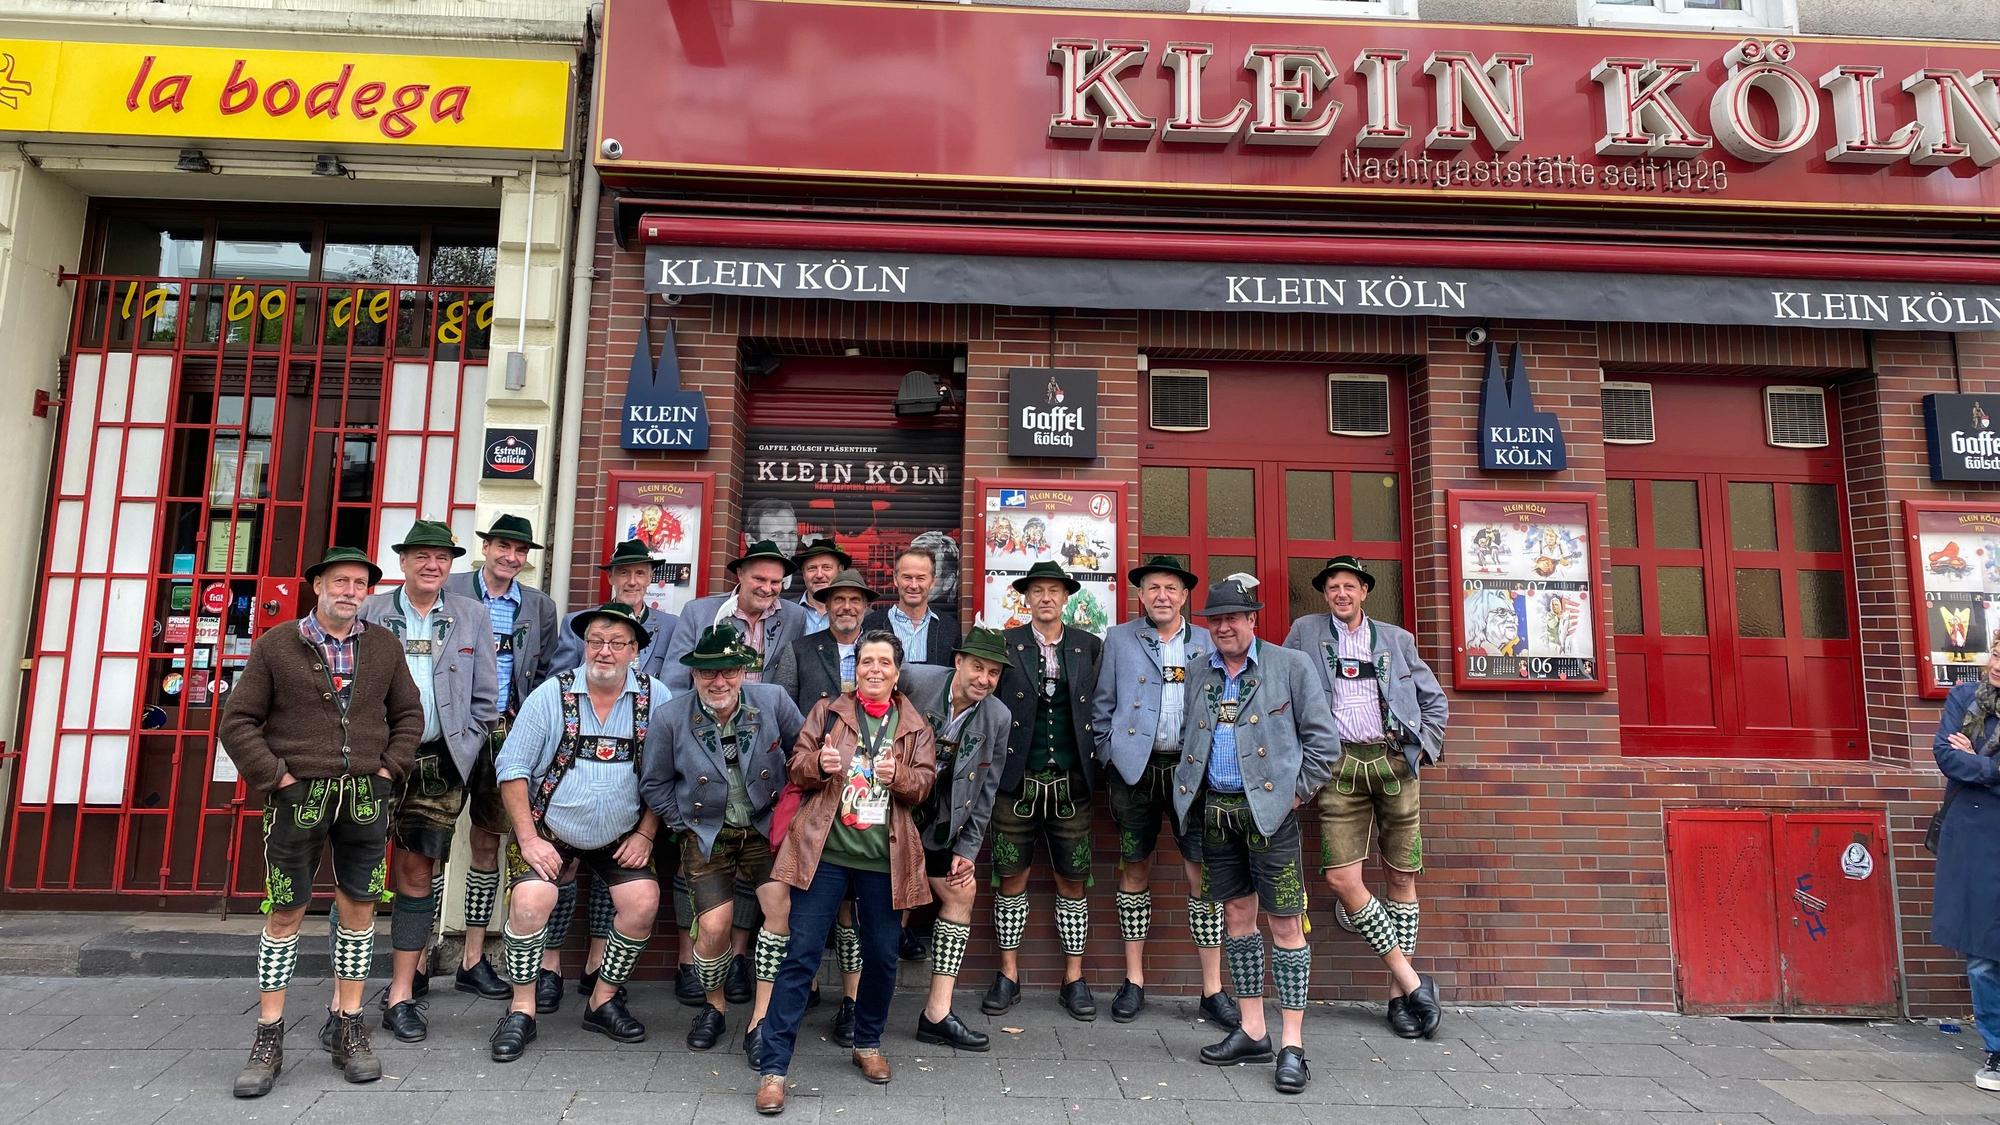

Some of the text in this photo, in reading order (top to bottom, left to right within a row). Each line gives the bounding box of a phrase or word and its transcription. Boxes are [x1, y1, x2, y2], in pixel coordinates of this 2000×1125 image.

[127, 56, 471, 139] la bodega
[1048, 37, 2000, 167] KLEIN KÖLN
[1343, 149, 1729, 190] Nachtgaststätte seit 1926
[657, 258, 910, 294] KLEIN KÖLN
[1225, 275, 1468, 309] KLEIN KÖLN
[1771, 291, 2000, 324] KLEIN KÖLN
[629, 404, 698, 424] KLEIN
[1022, 406, 1086, 432] Gaffel
[631, 427, 694, 446] KÖLN
[1490, 427, 1555, 443] KLEIN
[493, 446, 527, 456] Estrella
[758, 443, 878, 453] GAFFEL KÖLSCH PRÄSENTIERT
[1494, 446, 1552, 465] KÖLN
[494, 454, 525, 464] Galicia
[757, 460, 946, 485] KLEIN KÖLN
[637, 483, 684, 495] KLEIN KÖLN
[1029, 491, 1074, 503] KLEIN KÖLN
[1044, 503, 1056, 511] KK
[1502, 503, 1547, 514] KLEIN KÖLN
[1958, 514, 1979, 524] KLEIN
[1468, 656, 1487, 672] 10
[1531, 657, 1552, 674] 06
[1932, 665, 1950, 681] 11
